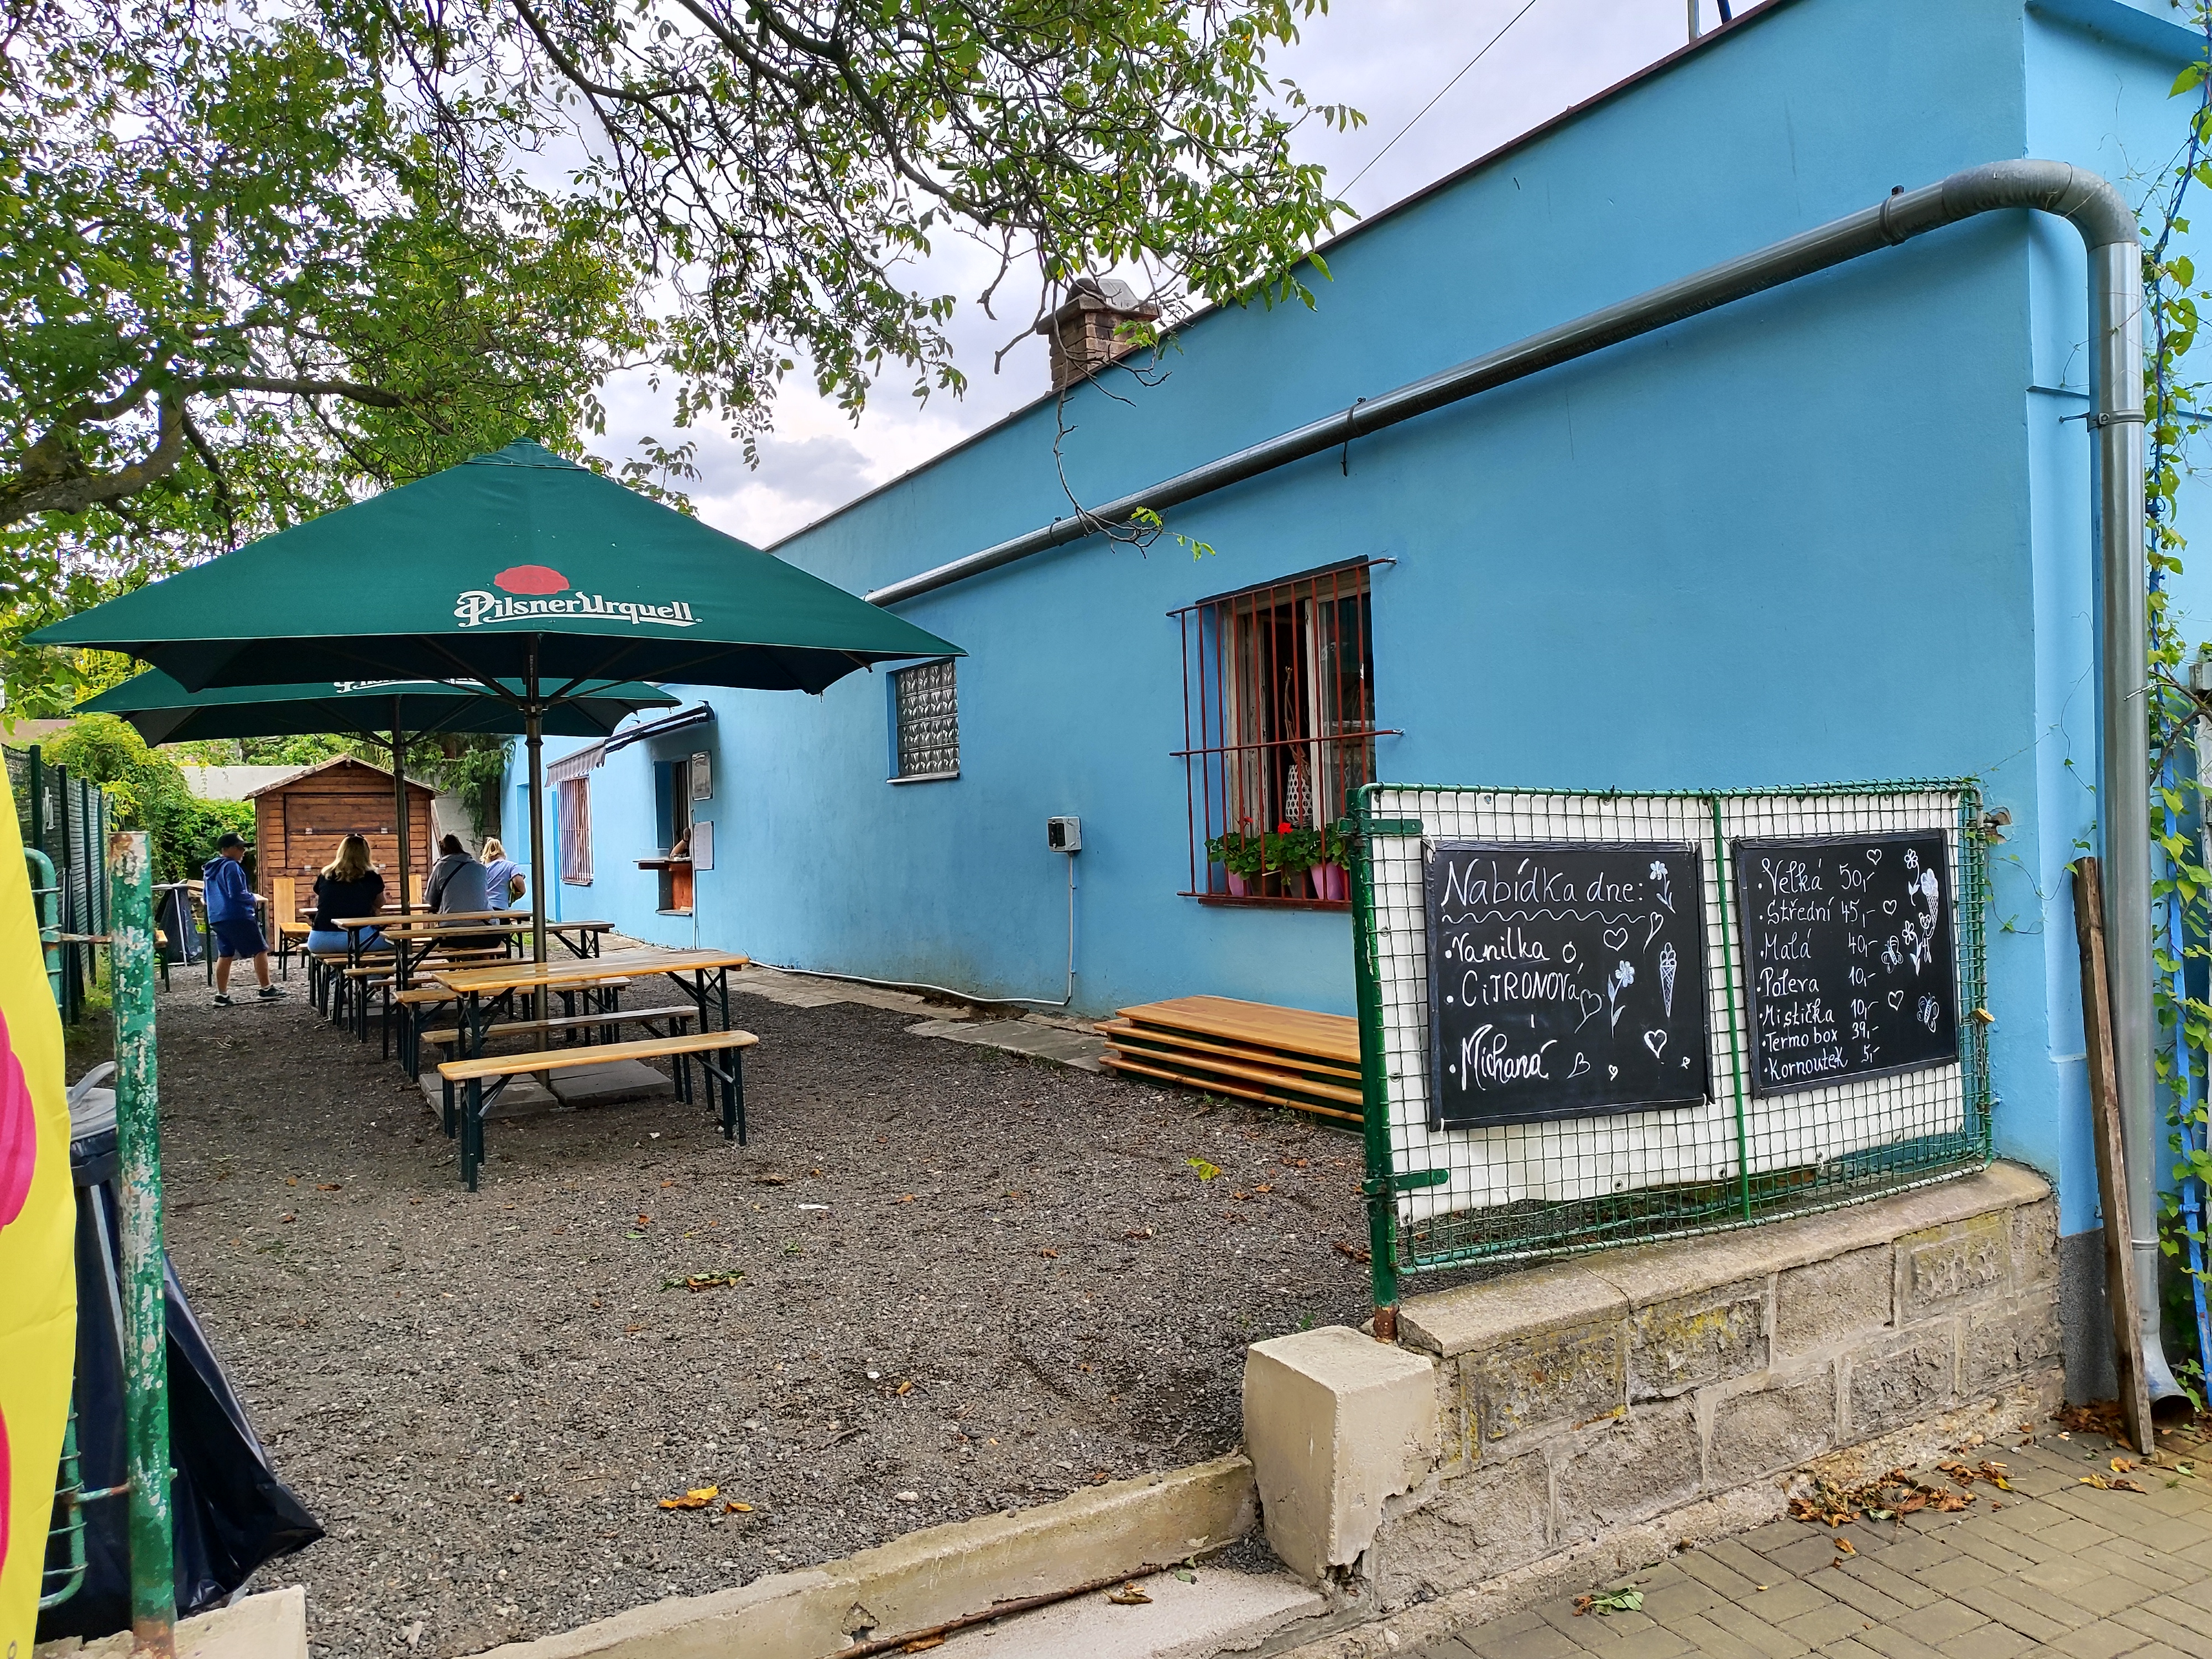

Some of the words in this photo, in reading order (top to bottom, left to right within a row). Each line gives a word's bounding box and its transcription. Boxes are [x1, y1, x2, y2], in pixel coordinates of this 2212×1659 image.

[454, 590, 581, 628] Pilsner
[575, 591, 695, 624] Urquell
[1440, 857, 1578, 907] Nabídka
[1586, 871, 1644, 902] dne:
[1762, 858, 1823, 895] Velká
[1767, 896, 1835, 925] Střední
[1452, 927, 1551, 963] Vanilka
[1764, 928, 1812, 961] Malá
[1766, 1032, 1809, 1053] Termo
[1813, 1027, 1839, 1044] box
